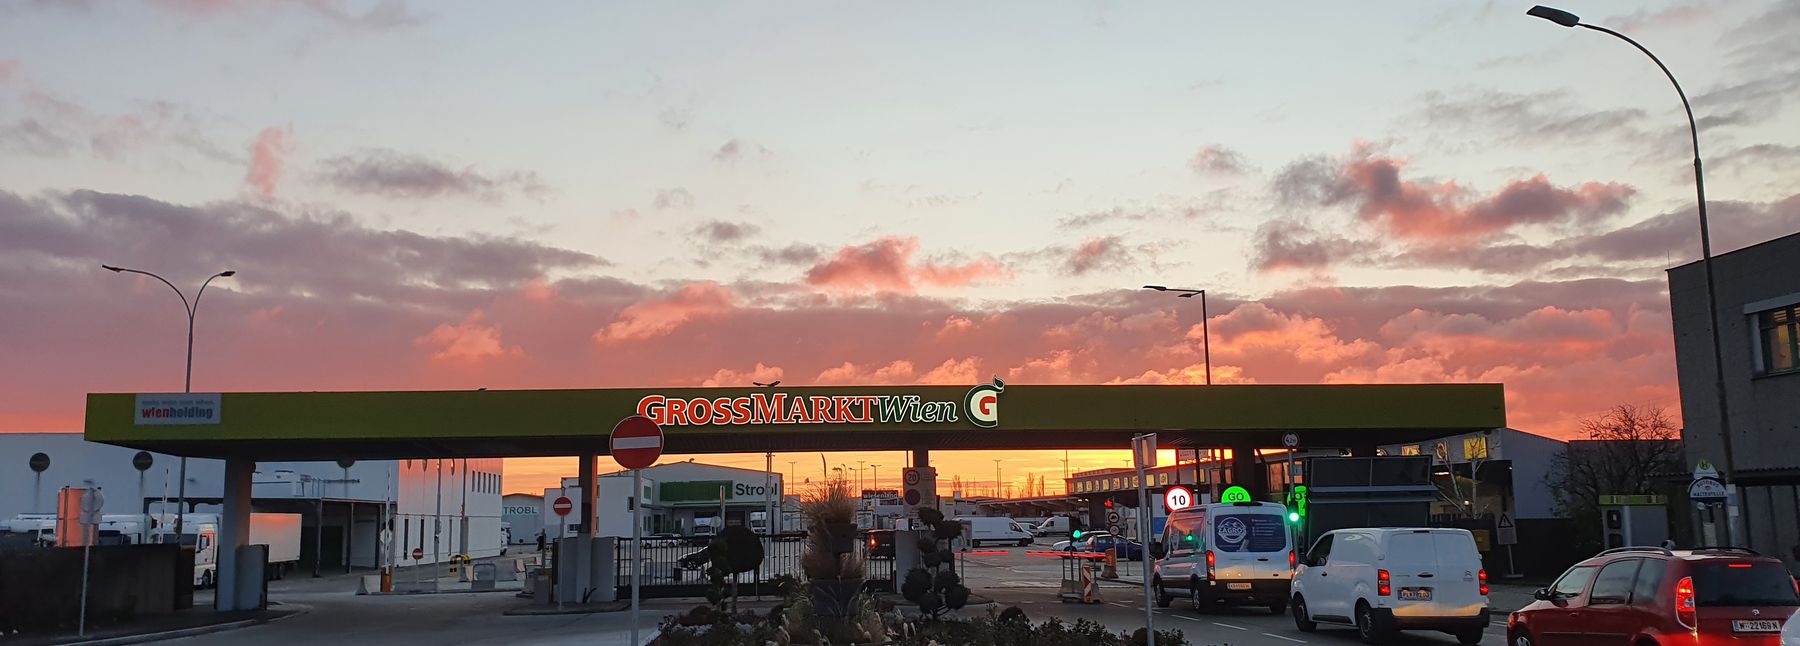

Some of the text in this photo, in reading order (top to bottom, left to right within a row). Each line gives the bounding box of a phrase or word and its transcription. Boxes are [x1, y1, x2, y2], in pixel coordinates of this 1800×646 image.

[142, 406, 213, 419] wienholding
[1172, 495, 1186, 506] 10
[1228, 493, 1245, 501] GO
